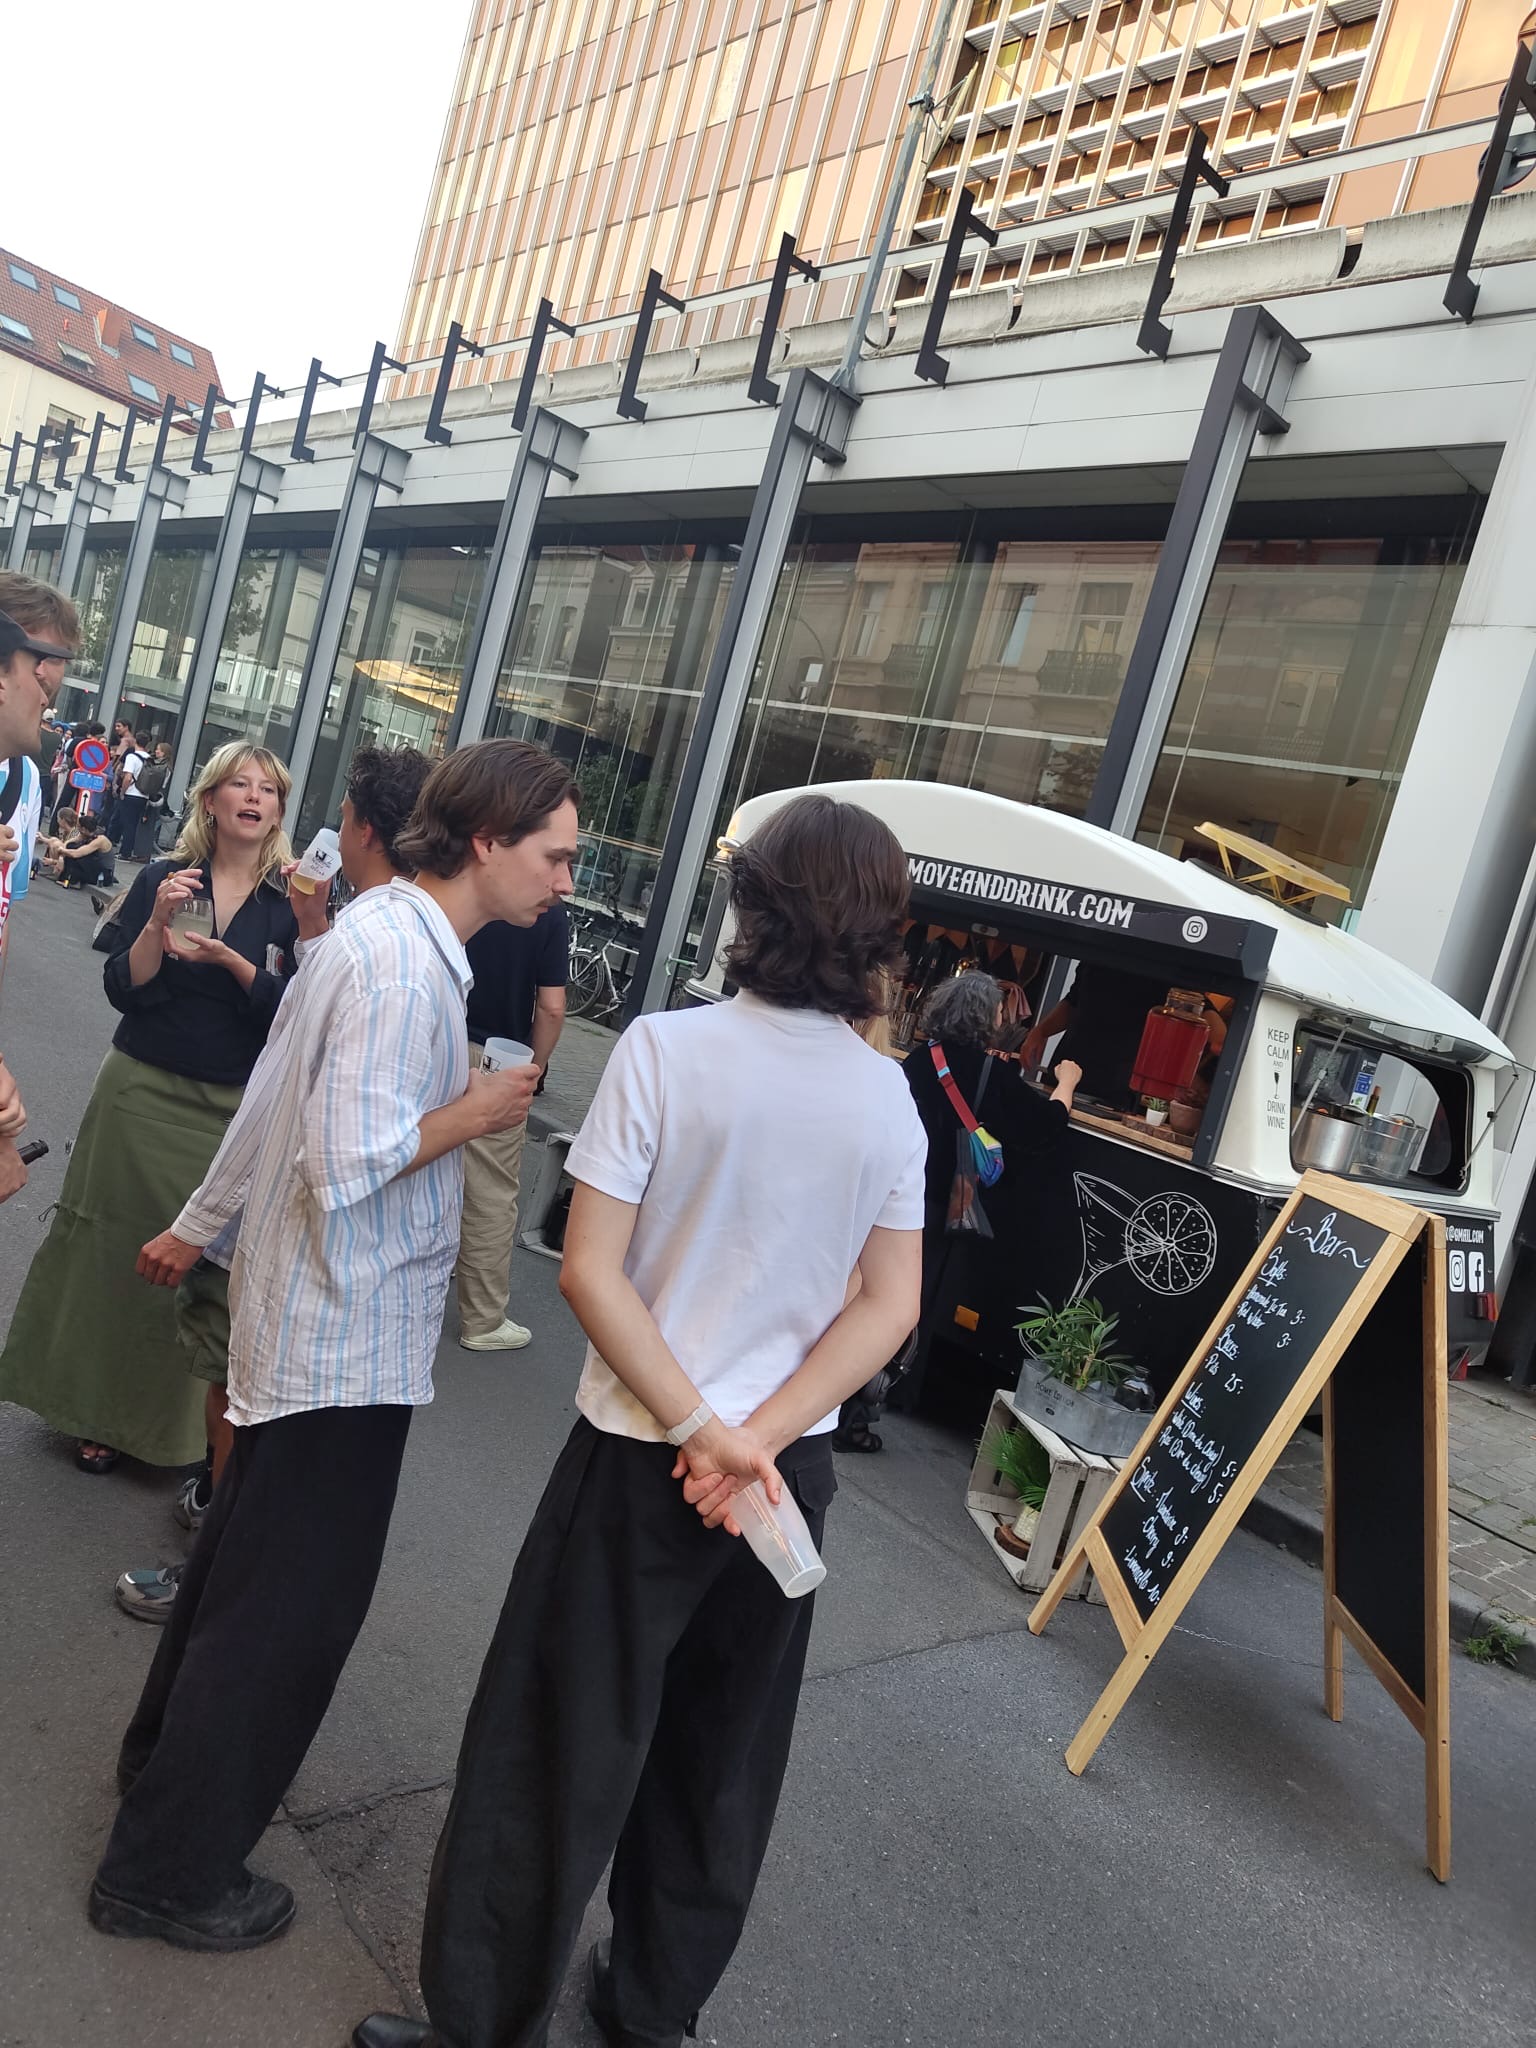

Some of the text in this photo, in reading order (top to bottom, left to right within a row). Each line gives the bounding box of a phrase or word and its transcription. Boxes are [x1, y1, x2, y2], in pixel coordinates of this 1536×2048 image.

[906, 857, 1136, 929] MOVEANDDRINK.COM
[1267, 1027, 1290, 1043] KEEP
[1266, 1044, 1290, 1060] CALM
[1273, 1060, 1284, 1068] AND
[1266, 1100, 1286, 1115] DRINK
[1266, 1115, 1286, 1130] WINE
[1303, 1212, 1348, 1258] Bar
